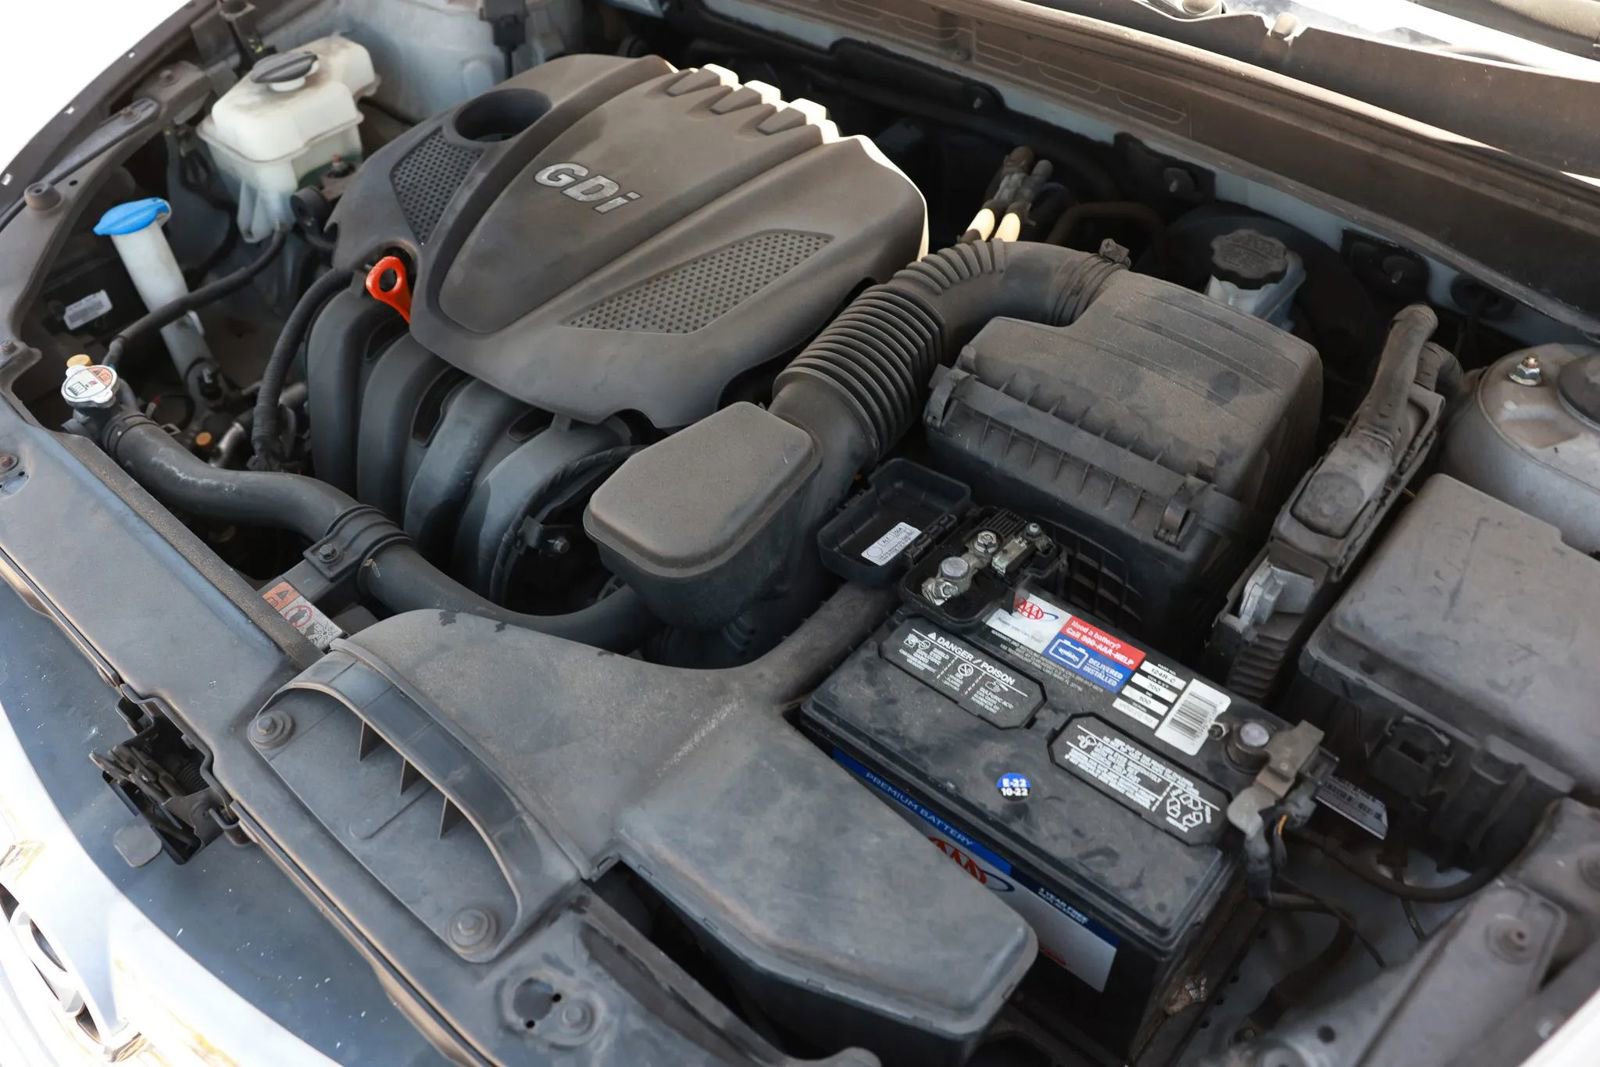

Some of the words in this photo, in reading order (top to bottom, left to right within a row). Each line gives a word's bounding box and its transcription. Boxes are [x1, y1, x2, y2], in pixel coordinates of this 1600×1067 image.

[534, 162, 641, 214] GDi
[1065, 627, 1081, 639] Call
[1071, 620, 1088, 632] Need
[1093, 632, 1121, 649] battery?
[937, 637, 974, 663] DANGER
[980, 661, 1016, 685] POISON
[1088, 658, 1124, 679] DELIVERED
[1083, 666, 1118, 687] INSTALLED
[865, 772, 918, 810] PREMIUM
[920, 808, 974, 846] BATTERY
